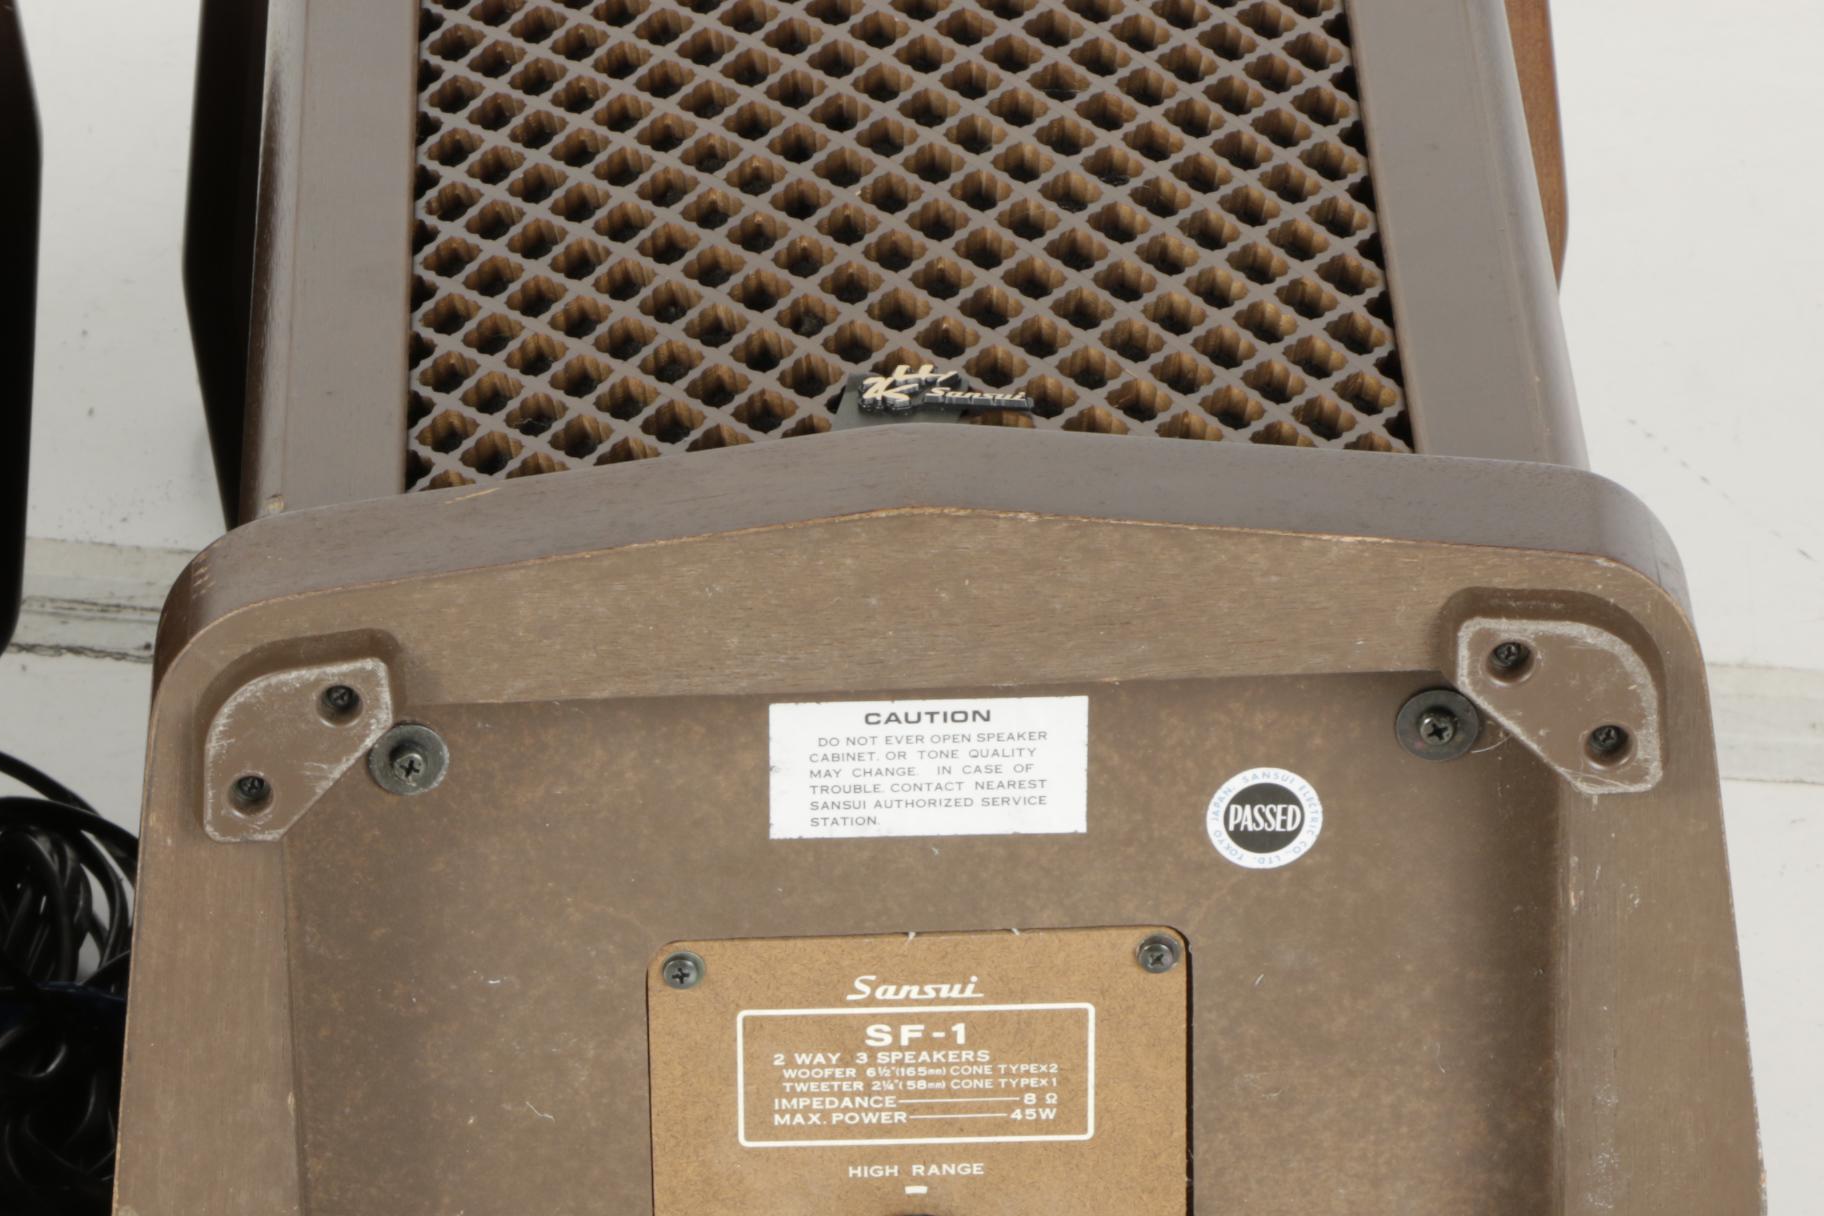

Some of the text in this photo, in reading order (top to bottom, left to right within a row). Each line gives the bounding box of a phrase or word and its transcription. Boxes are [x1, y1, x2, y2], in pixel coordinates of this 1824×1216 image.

[926, 387, 1026, 400] Sansui
[864, 709, 992, 725] CAUTION
[818, 731, 1047, 747] DO NOT EVER OPEN SPEAKER
[885, 751, 906, 760] OR
[918, 749, 959, 760] TONE
[968, 748, 1036, 758] QUALITY
[809, 769, 841, 779] MAY
[937, 766, 952, 775] IN
[962, 764, 1003, 775] CASE
[1013, 764, 1035, 773] OF
[890, 781, 964, 793] CONTACT
[975, 780, 1047, 791] NEAREST
[810, 796, 1047, 811] SANSUI AUTHORIZED SERVICE
[1228, 804, 1301, 832] PASSED
[846, 976, 984, 1001] Sansui
[865, 1023, 966, 1047] SF-1
[773, 1050, 990, 1065] 2 WAY 3 SPEAKERS
[783, 1068, 856, 1078] WOOFER
[950, 1065, 993, 1075] CONE
[783, 1081, 864, 1092] TWEETER
[951, 1079, 993, 1089] CONE
[774, 1096, 897, 1110] IMPEDANCE
[1024, 1093, 1036, 1105] 8
[774, 1108, 1056, 1125] MAX. POWER 45W
[848, 1163, 984, 1178] HIGH RANGE
